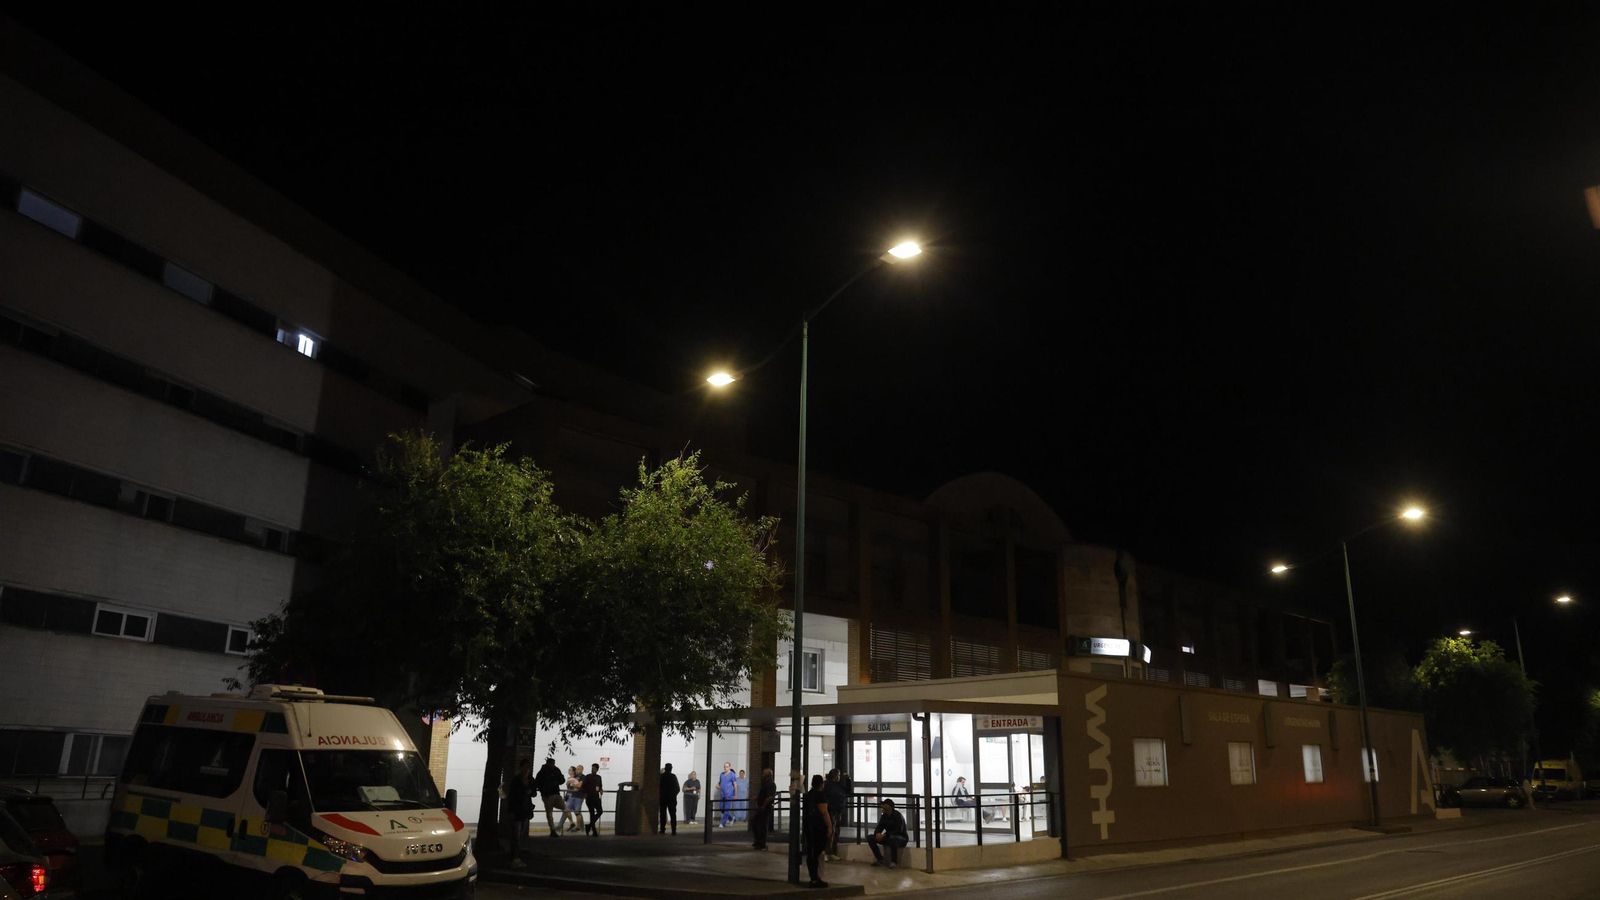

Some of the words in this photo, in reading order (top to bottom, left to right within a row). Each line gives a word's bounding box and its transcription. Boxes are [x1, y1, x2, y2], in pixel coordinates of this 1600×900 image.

[868, 722, 891, 732] SALIDA
[991, 718, 1028, 728] ENTRADA
[406, 843, 443, 855] IVECO
